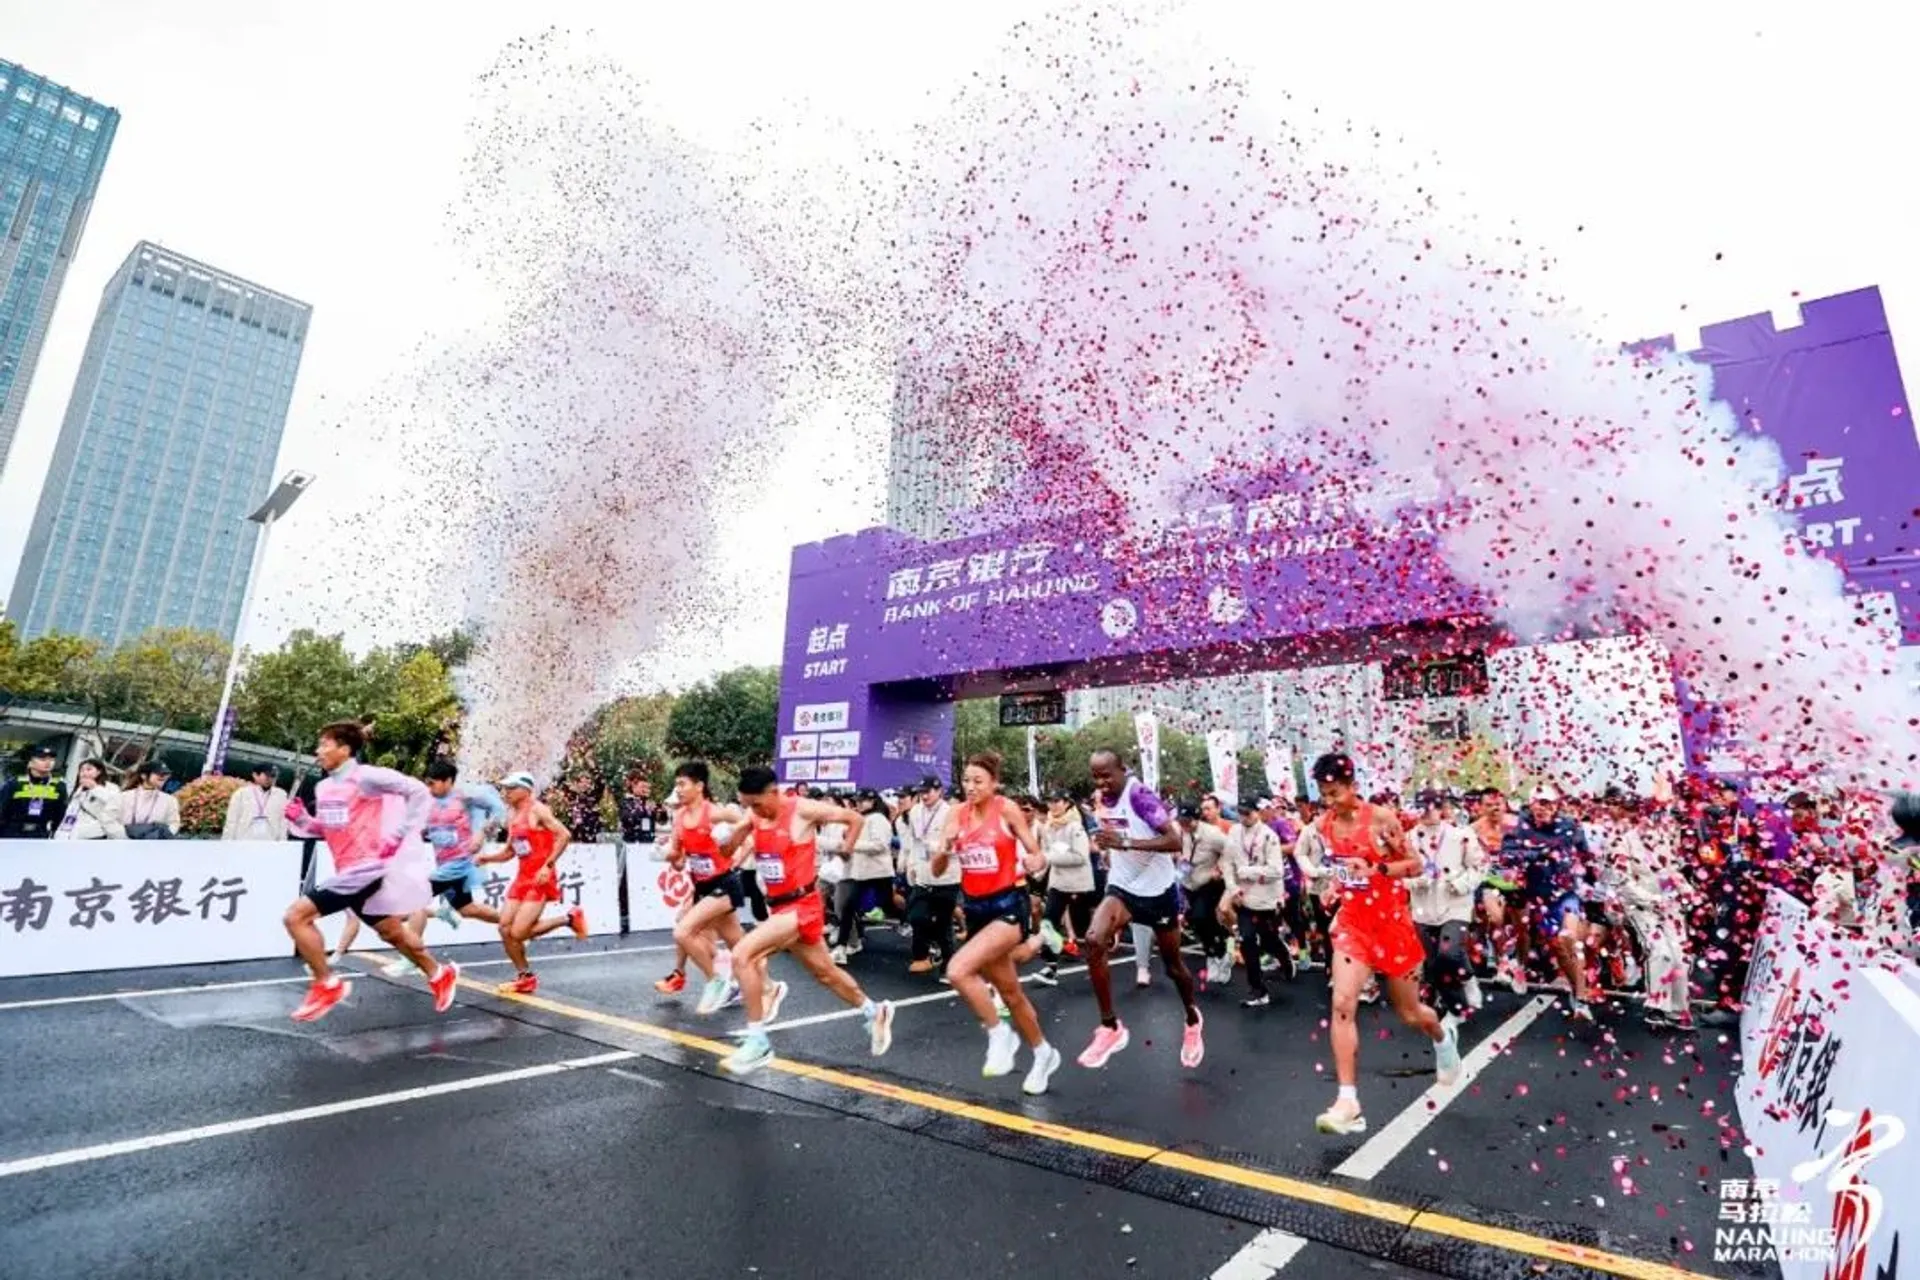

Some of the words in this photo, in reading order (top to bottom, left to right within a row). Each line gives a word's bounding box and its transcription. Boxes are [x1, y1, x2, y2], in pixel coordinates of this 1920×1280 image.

[884, 599, 943, 624] BANK
[948, 591, 980, 613] OF
[806, 623, 850, 655] 起点
[803, 657, 849, 679] START
